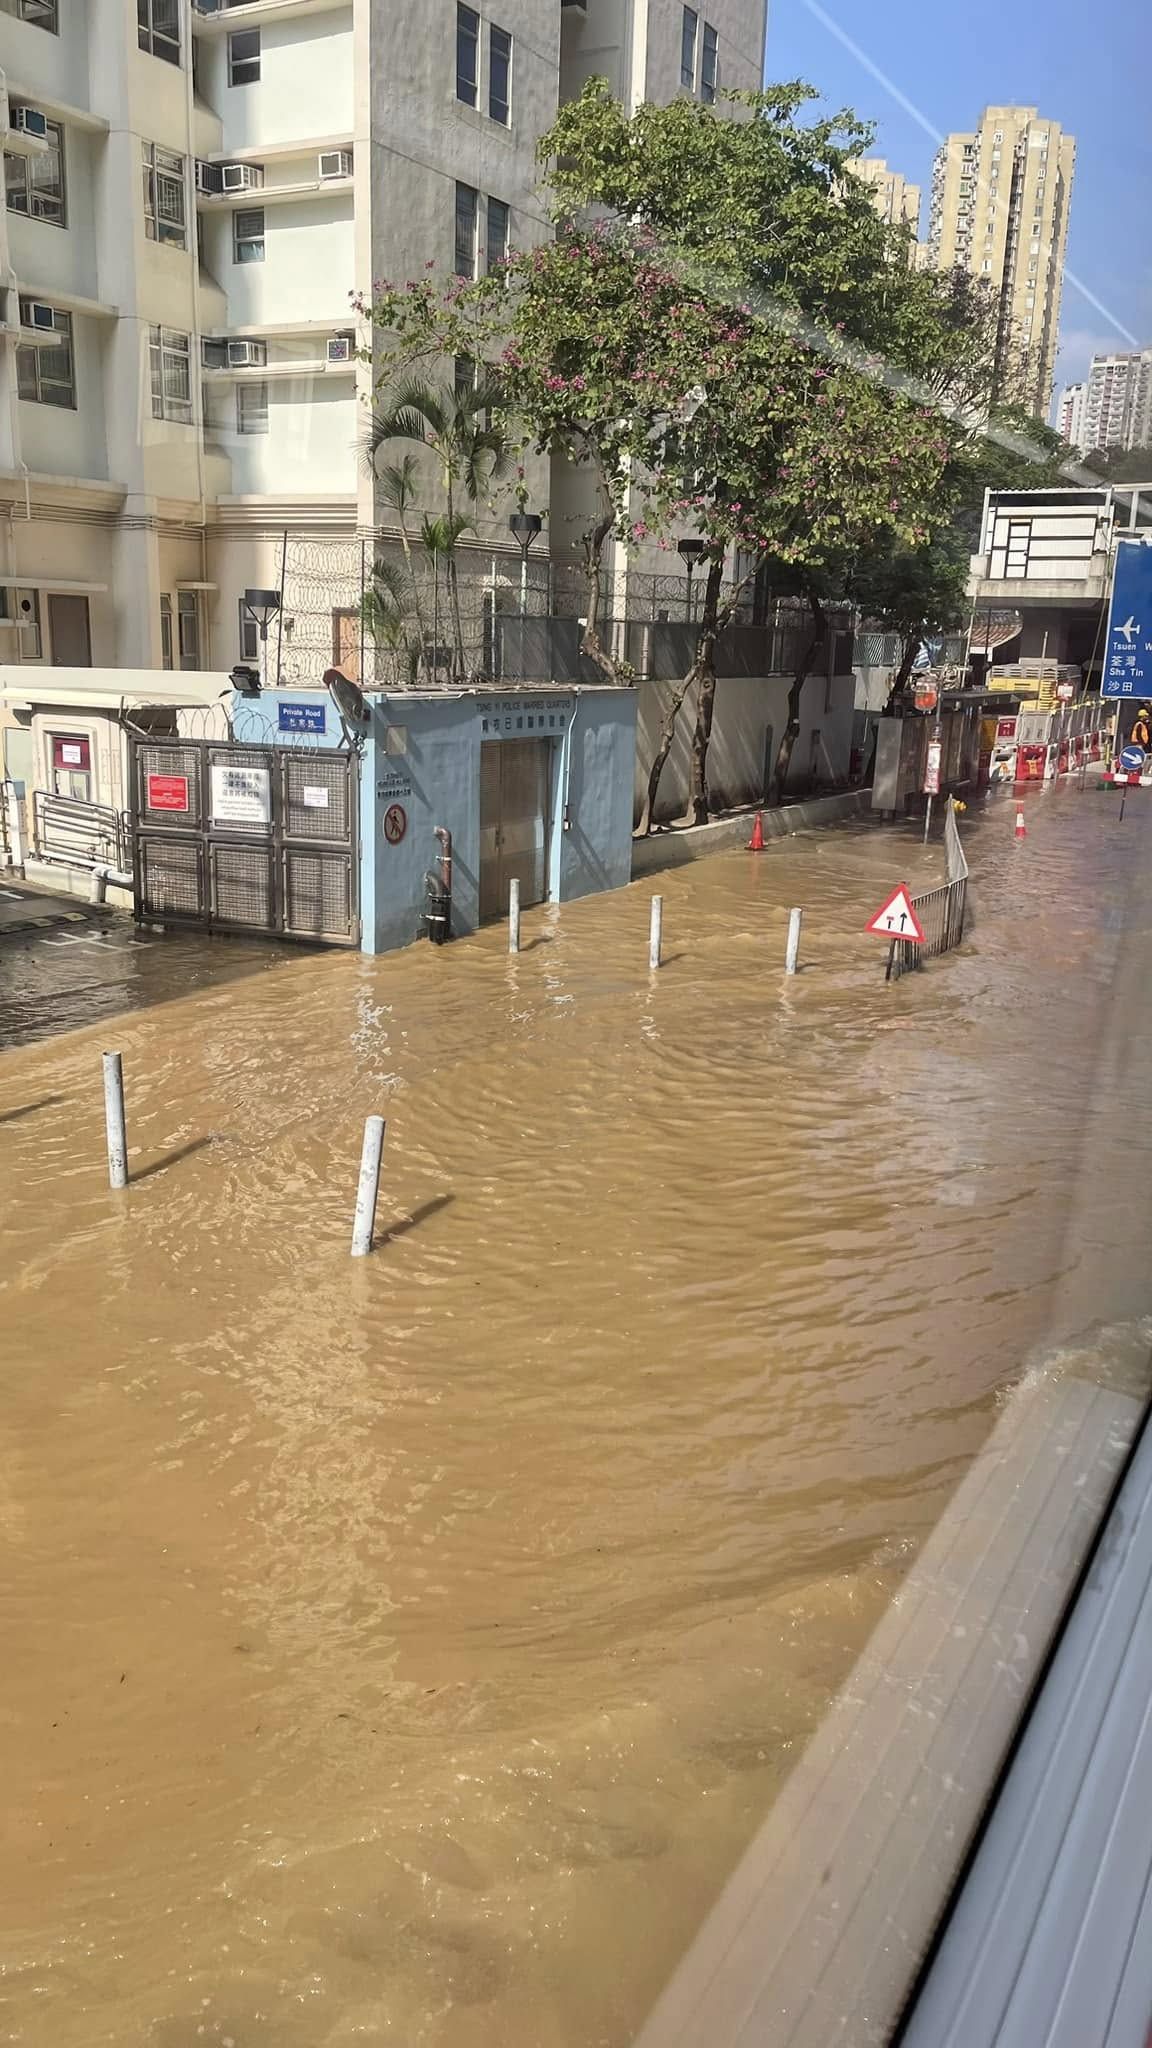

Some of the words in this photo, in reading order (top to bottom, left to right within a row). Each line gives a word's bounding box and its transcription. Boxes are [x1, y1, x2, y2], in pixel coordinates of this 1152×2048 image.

[1113, 641, 1136, 651] Tsuen
[1111, 655, 1136, 667] 荃灣
[1109, 667, 1125, 676] Sha
[1130, 668, 1144, 677] Tin
[1107, 680, 1133, 692] 沙田
[282, 707, 304, 716] Private
[305, 708, 321, 718] Road
